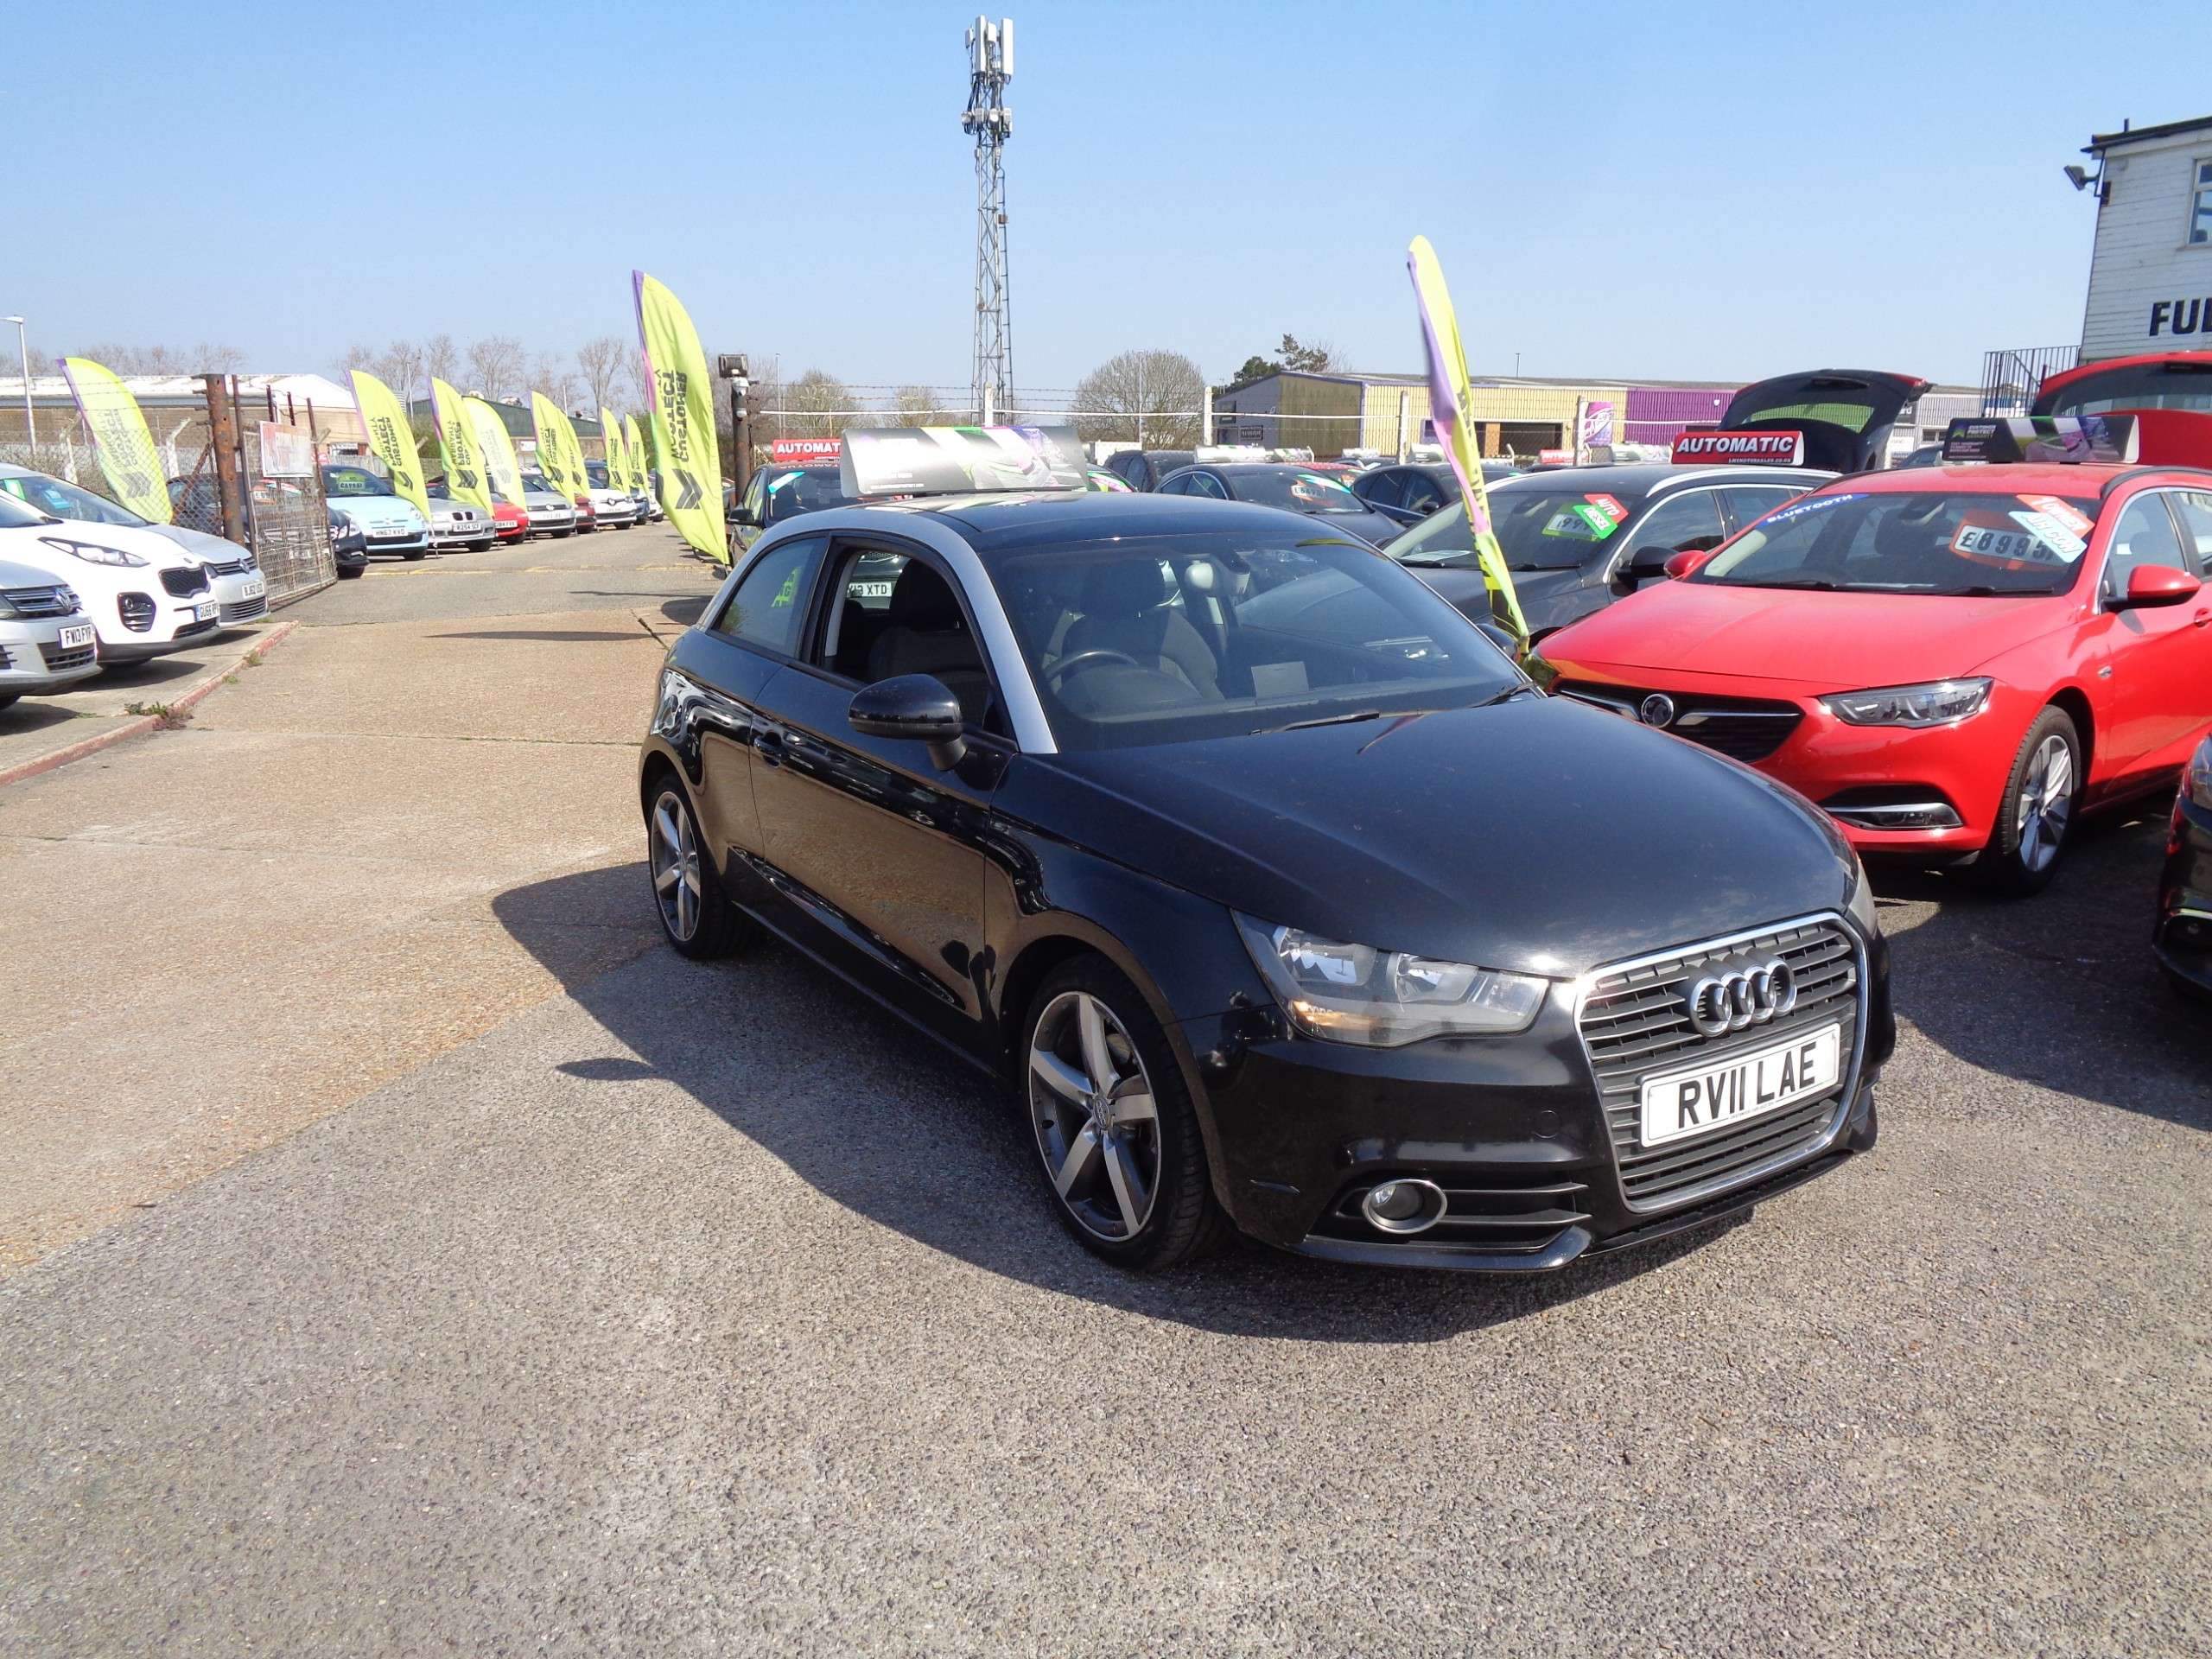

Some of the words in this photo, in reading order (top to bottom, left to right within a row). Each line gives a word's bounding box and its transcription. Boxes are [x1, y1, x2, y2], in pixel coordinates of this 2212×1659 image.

[777, 442, 842, 454] AUTOMAT
[1676, 436, 1794, 453] AUTOMATIC
[1595, 498, 1620, 516] AUTO
[1767, 494, 1853, 524] BLUETOOTH
[867, 584, 887, 595] XTD
[1678, 1067, 1746, 1128] RV11
[1756, 1042, 1817, 1105] LAE
